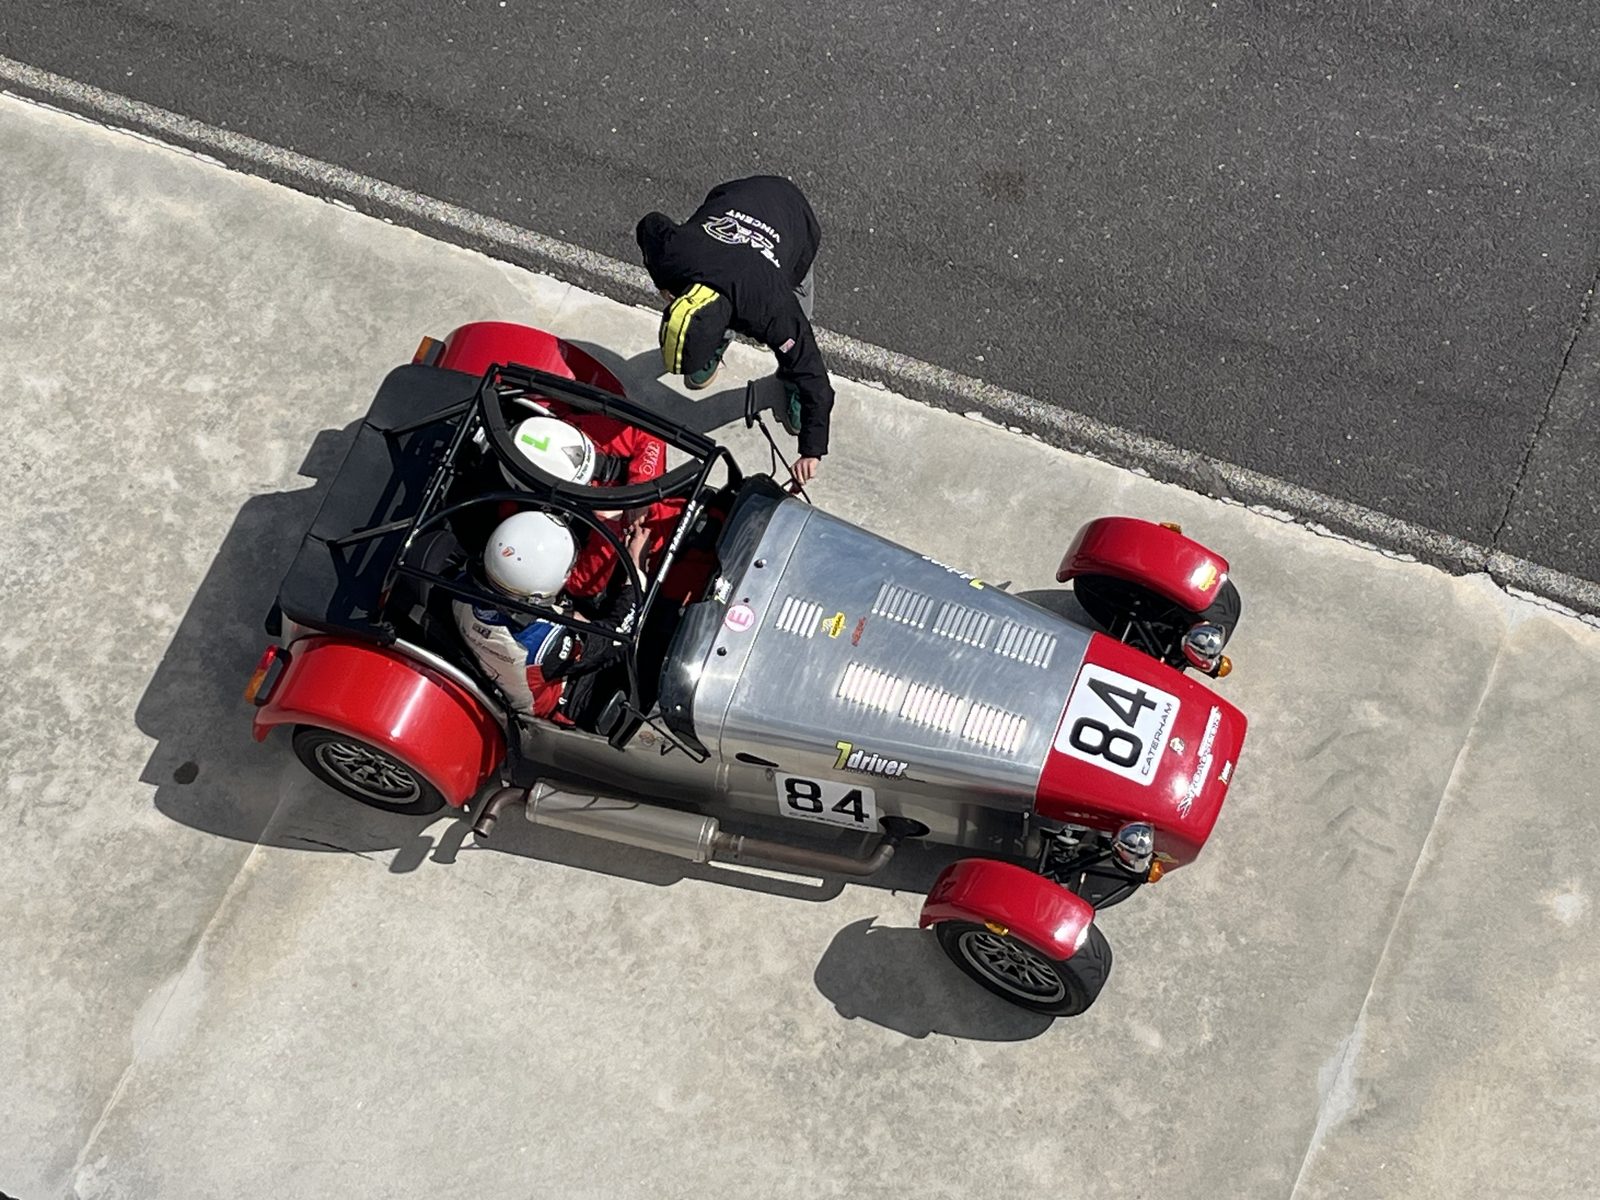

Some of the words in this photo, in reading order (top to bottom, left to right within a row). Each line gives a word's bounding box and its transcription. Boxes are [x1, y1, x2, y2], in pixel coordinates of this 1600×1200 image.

[725, 209, 780, 244] VINCENT
[733, 233, 780, 268] TEAM
[1069, 677, 1157, 768] 84
[1141, 702, 1173, 776] CATERHAM
[832, 741, 908, 776] 7driver
[784, 777, 869, 823] 84
